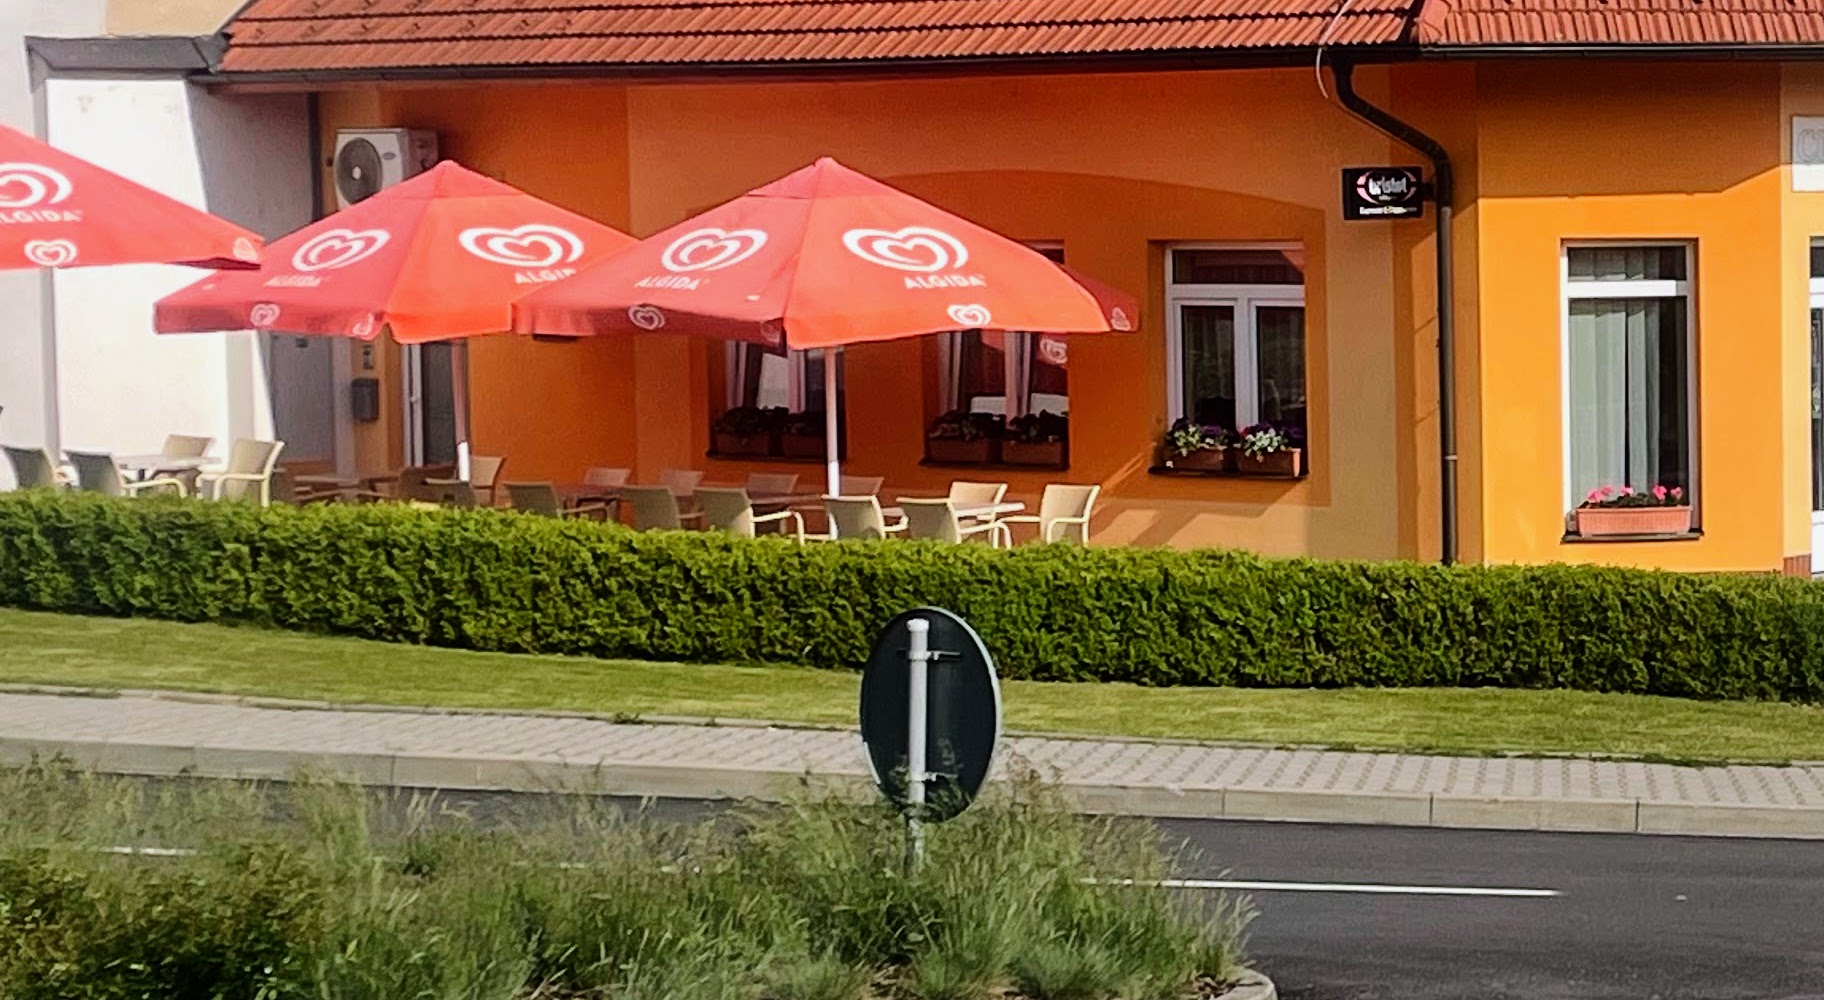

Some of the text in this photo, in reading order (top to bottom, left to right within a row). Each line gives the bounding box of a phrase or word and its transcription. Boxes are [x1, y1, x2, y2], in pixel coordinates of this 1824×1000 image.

[0, 210, 82, 223] LGIDA
[634, 276, 700, 291] ALGIDA
[903, 274, 987, 290] ALGIDA
